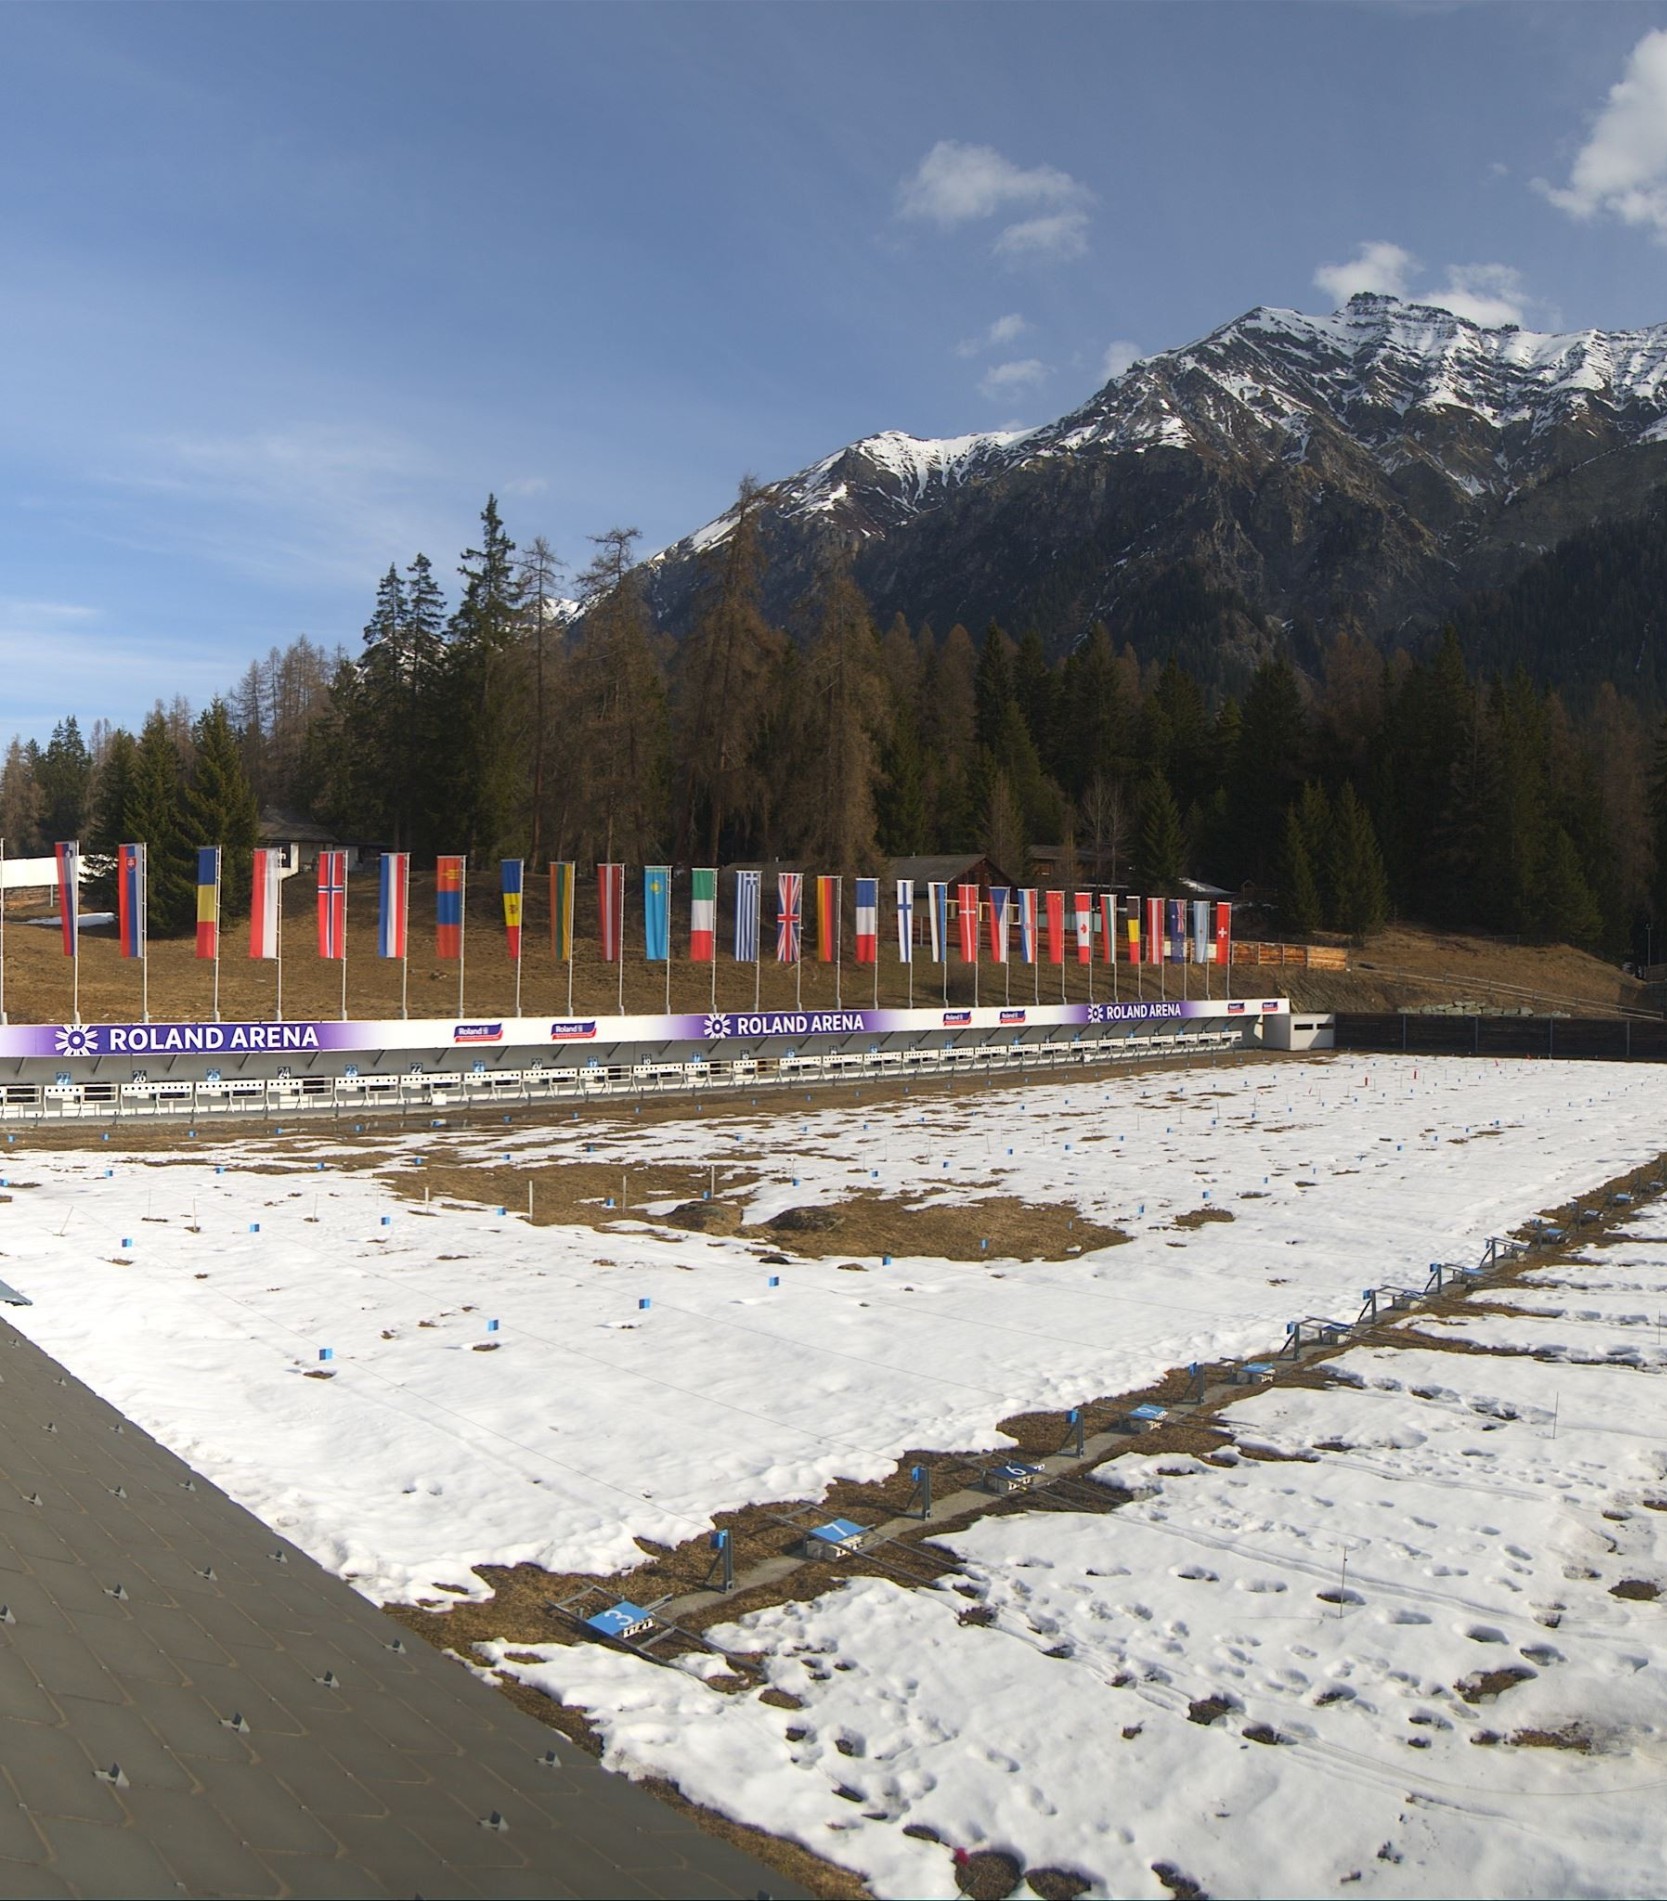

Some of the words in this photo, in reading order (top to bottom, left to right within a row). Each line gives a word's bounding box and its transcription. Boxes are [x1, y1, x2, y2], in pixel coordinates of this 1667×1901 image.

[1106, 1005, 1148, 1020] ROLAND
[1150, 1003, 1182, 1017] ARENA
[555, 1025, 578, 1033] Roland
[737, 1015, 807, 1035] ROLAND
[810, 1013, 865, 1032] ARENA
[458, 1027, 482, 1036] Roland
[109, 1028, 223, 1050] ROLAND
[230, 1026, 319, 1048] ARENA
[207, 1068, 220, 1081] 25
[278, 1066, 291, 1078] 24
[411, 1063, 422, 1074] 22
[57, 1072, 70, 1084] 27
[133, 1070, 147, 1083] 26
